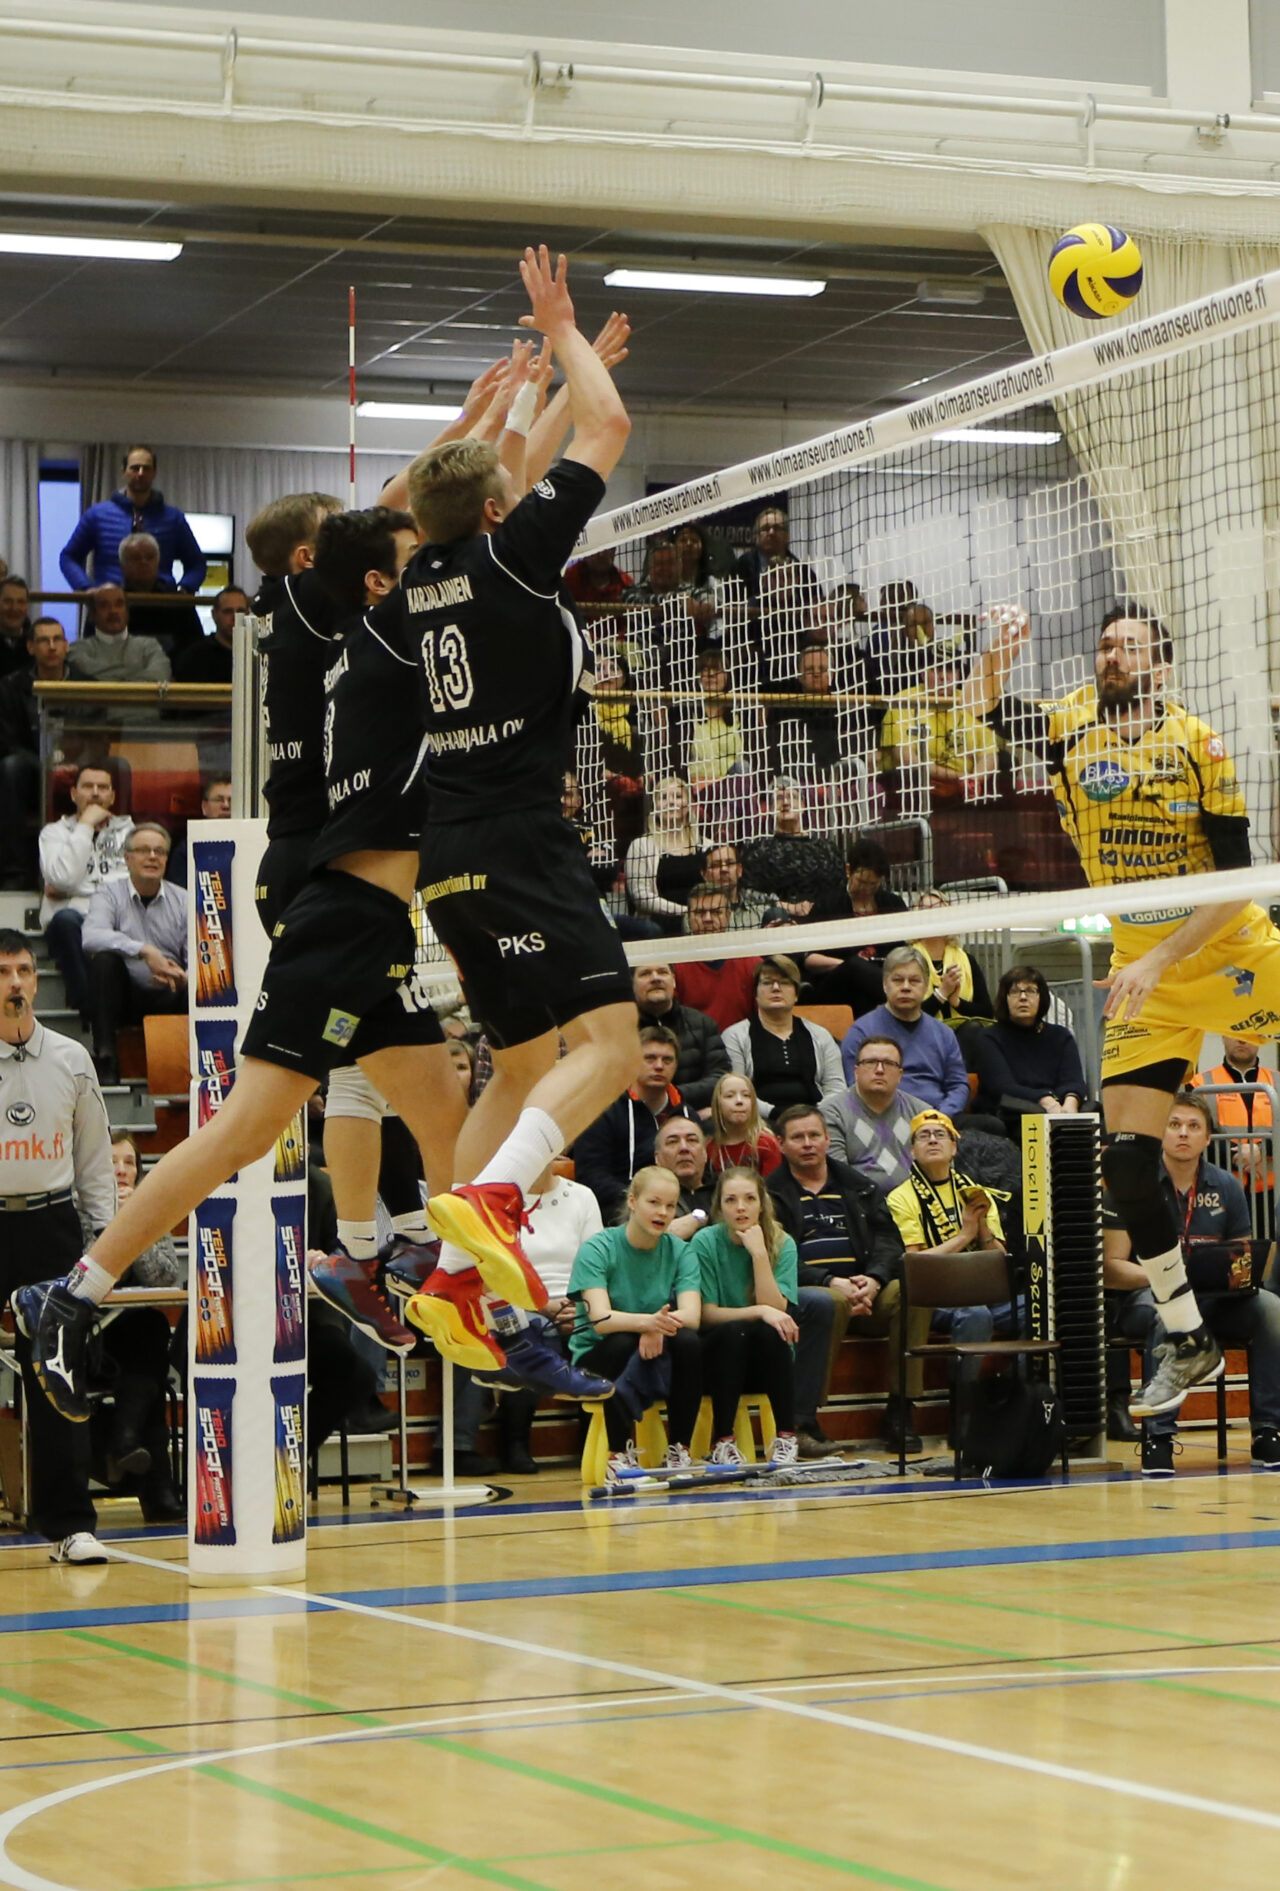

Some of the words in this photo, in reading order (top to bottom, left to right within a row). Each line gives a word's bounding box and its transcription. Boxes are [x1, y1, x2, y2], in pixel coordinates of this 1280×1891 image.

[1094, 278, 1268, 367] www.loimaanseurahuone.fi
[907, 356, 1056, 432] www.loimaanseurahuone.fi
[748, 420, 876, 487] www.loimaanseurahuone.fi
[612, 474, 722, 534] www.loimaanseurahuone.fi
[405, 574, 474, 614] KARJALAINEN
[421, 623, 474, 714] 13
[353, 768, 371, 791] OY
[199, 871, 225, 941] SPORT
[211, 871, 227, 911] TEHO
[497, 932, 546, 959] PKS
[200, 1228, 225, 1298] SPORT
[211, 1228, 228, 1268] TEHO
[281, 1226, 302, 1295] SPORT
[199, 1408, 225, 1479] SPORT
[211, 1408, 228, 1448] TEHO
[281, 1405, 302, 1473] SPORT
